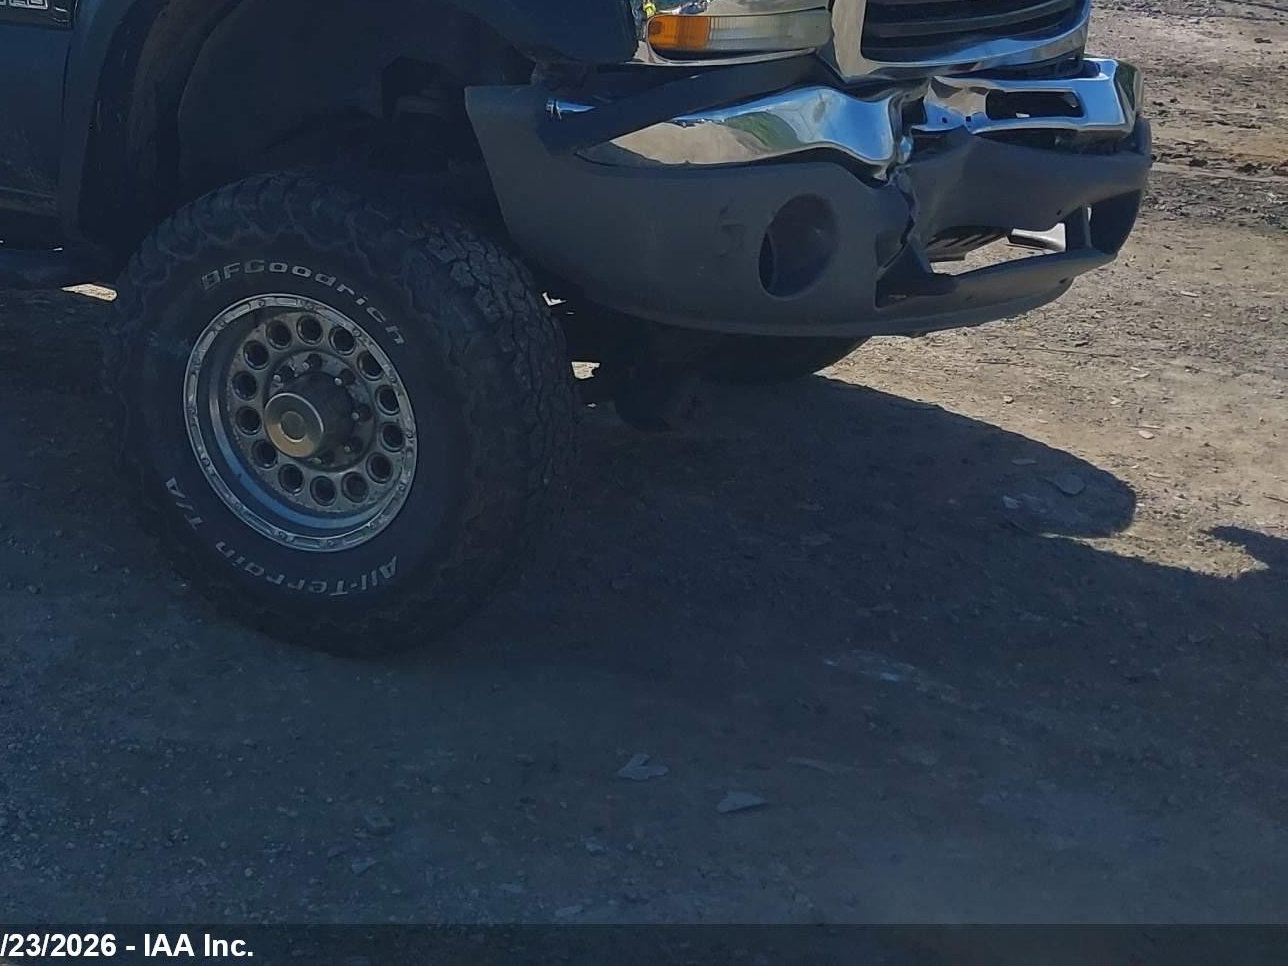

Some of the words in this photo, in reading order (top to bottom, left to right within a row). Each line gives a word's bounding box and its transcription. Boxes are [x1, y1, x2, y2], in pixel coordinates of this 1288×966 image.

[201, 259, 405, 345] BFGoodrich
[165, 477, 204, 531] T/A
[214, 540, 398, 597] All-Terrain
